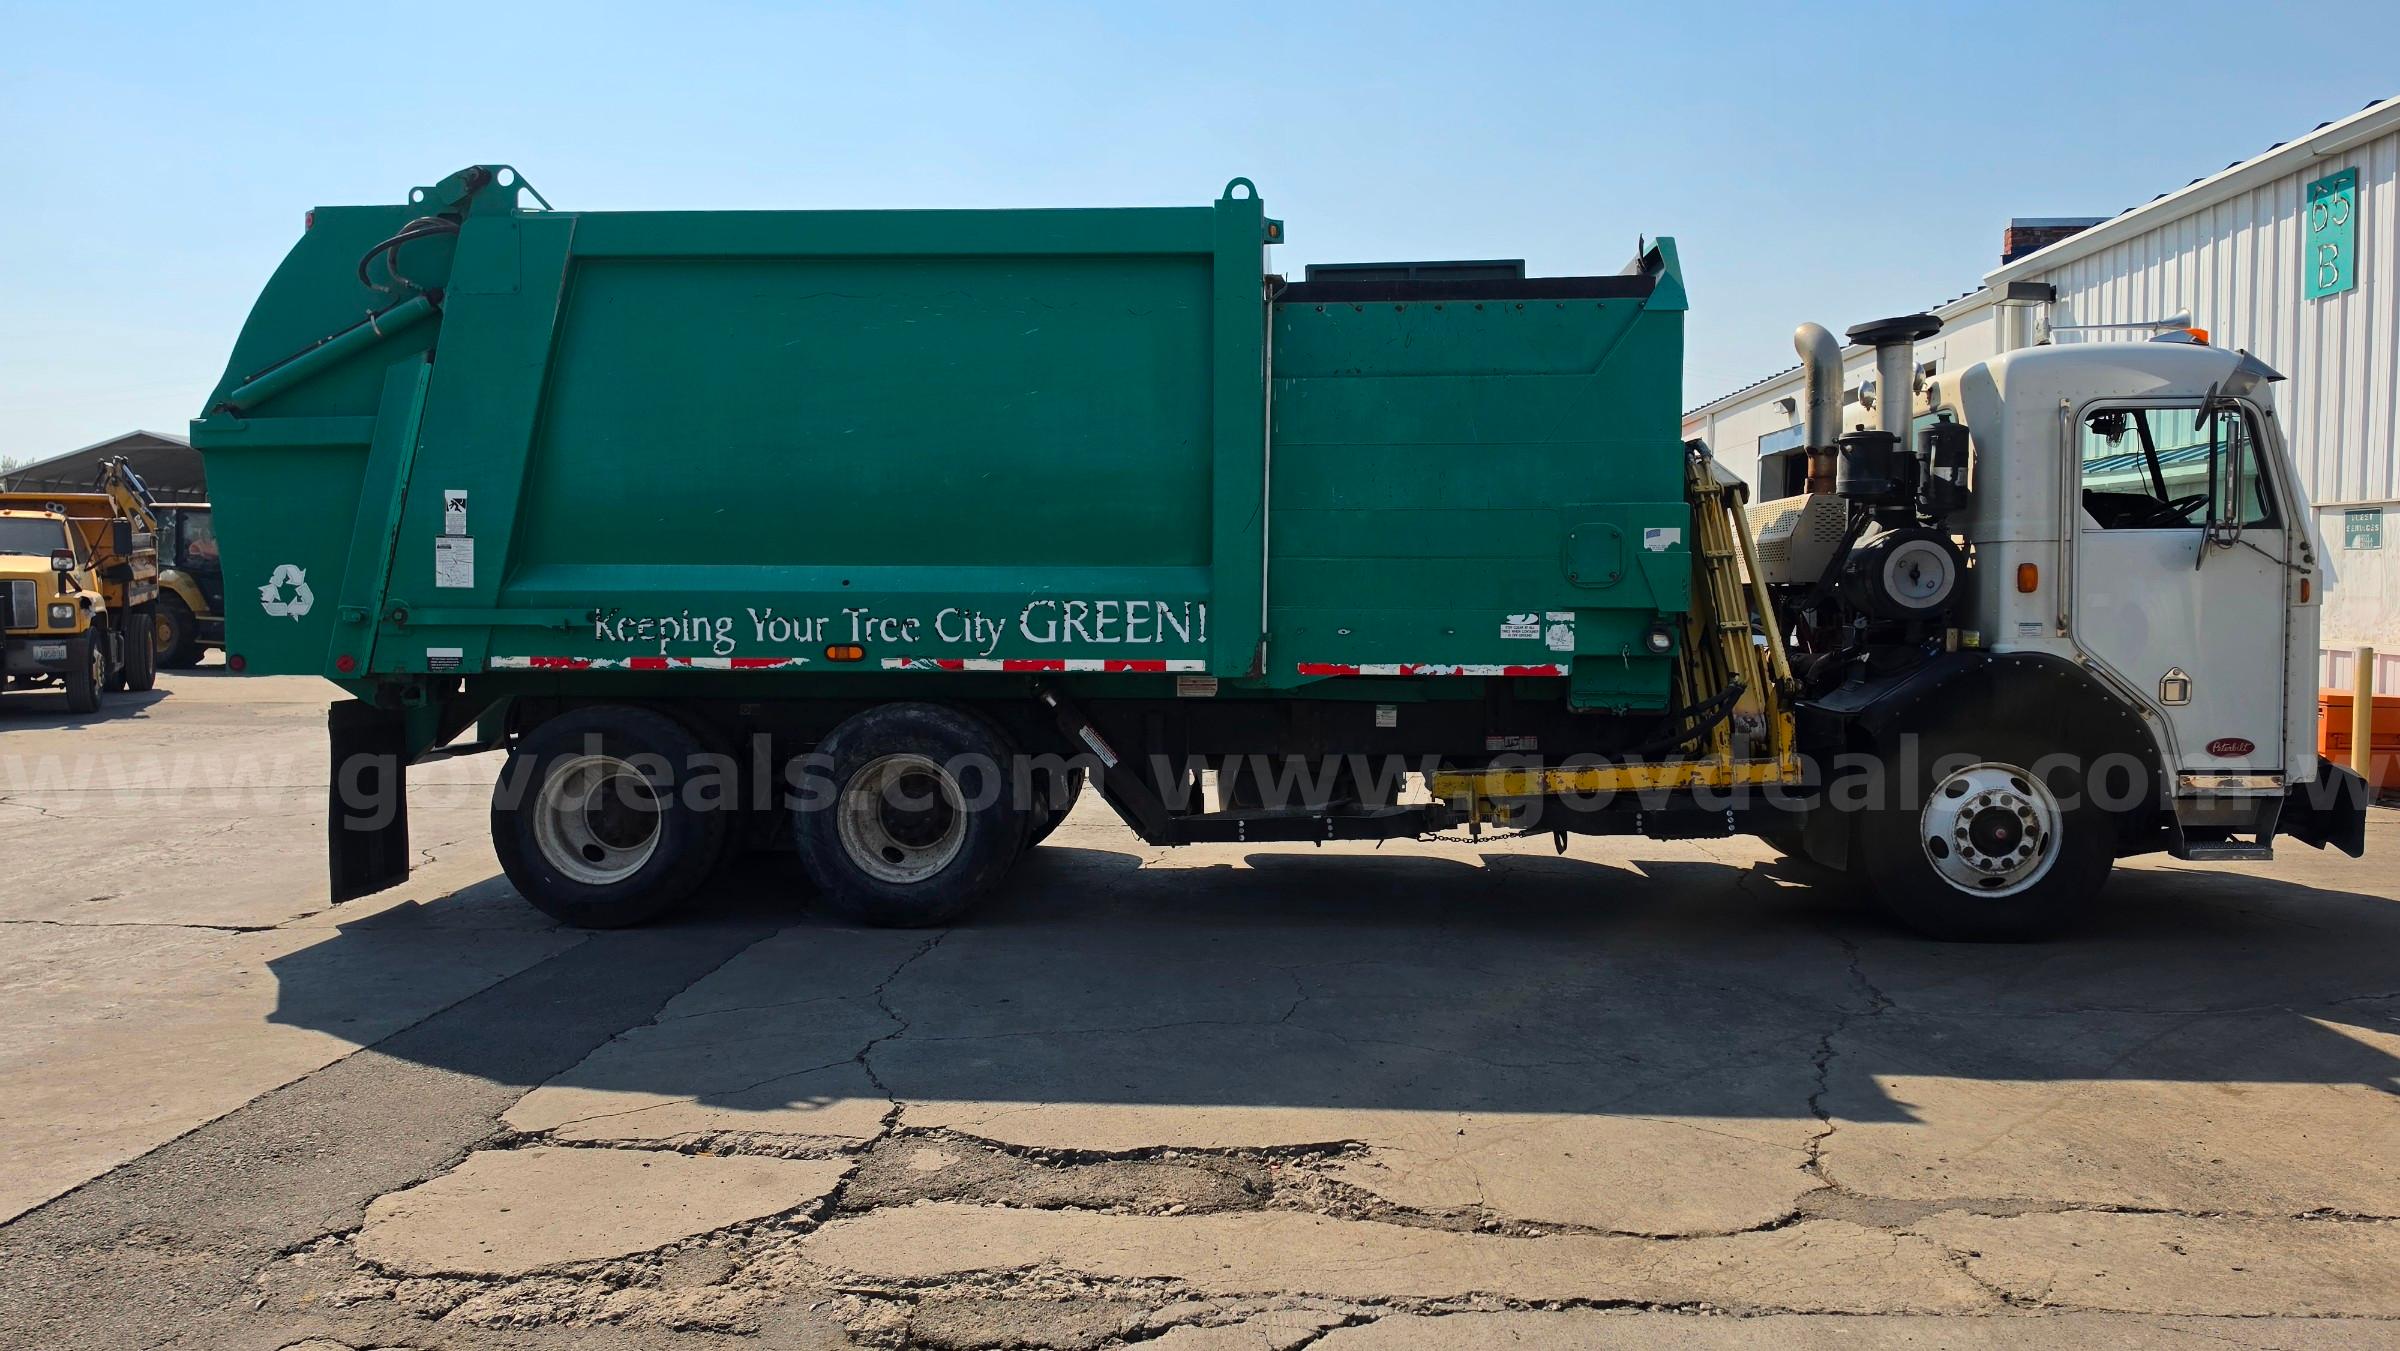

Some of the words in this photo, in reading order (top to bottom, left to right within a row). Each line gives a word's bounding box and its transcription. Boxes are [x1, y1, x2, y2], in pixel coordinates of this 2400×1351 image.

[2312, 178, 2350, 232] 65
[2318, 243, 2339, 289] B
[594, 607, 737, 656] Keeping
[746, 607, 830, 643] Your
[842, 607, 921, 643] Tree
[934, 607, 1006, 656] City
[1019, 599, 1208, 644] GREEN!
[2212, 742, 2252, 753] Peterbilt
